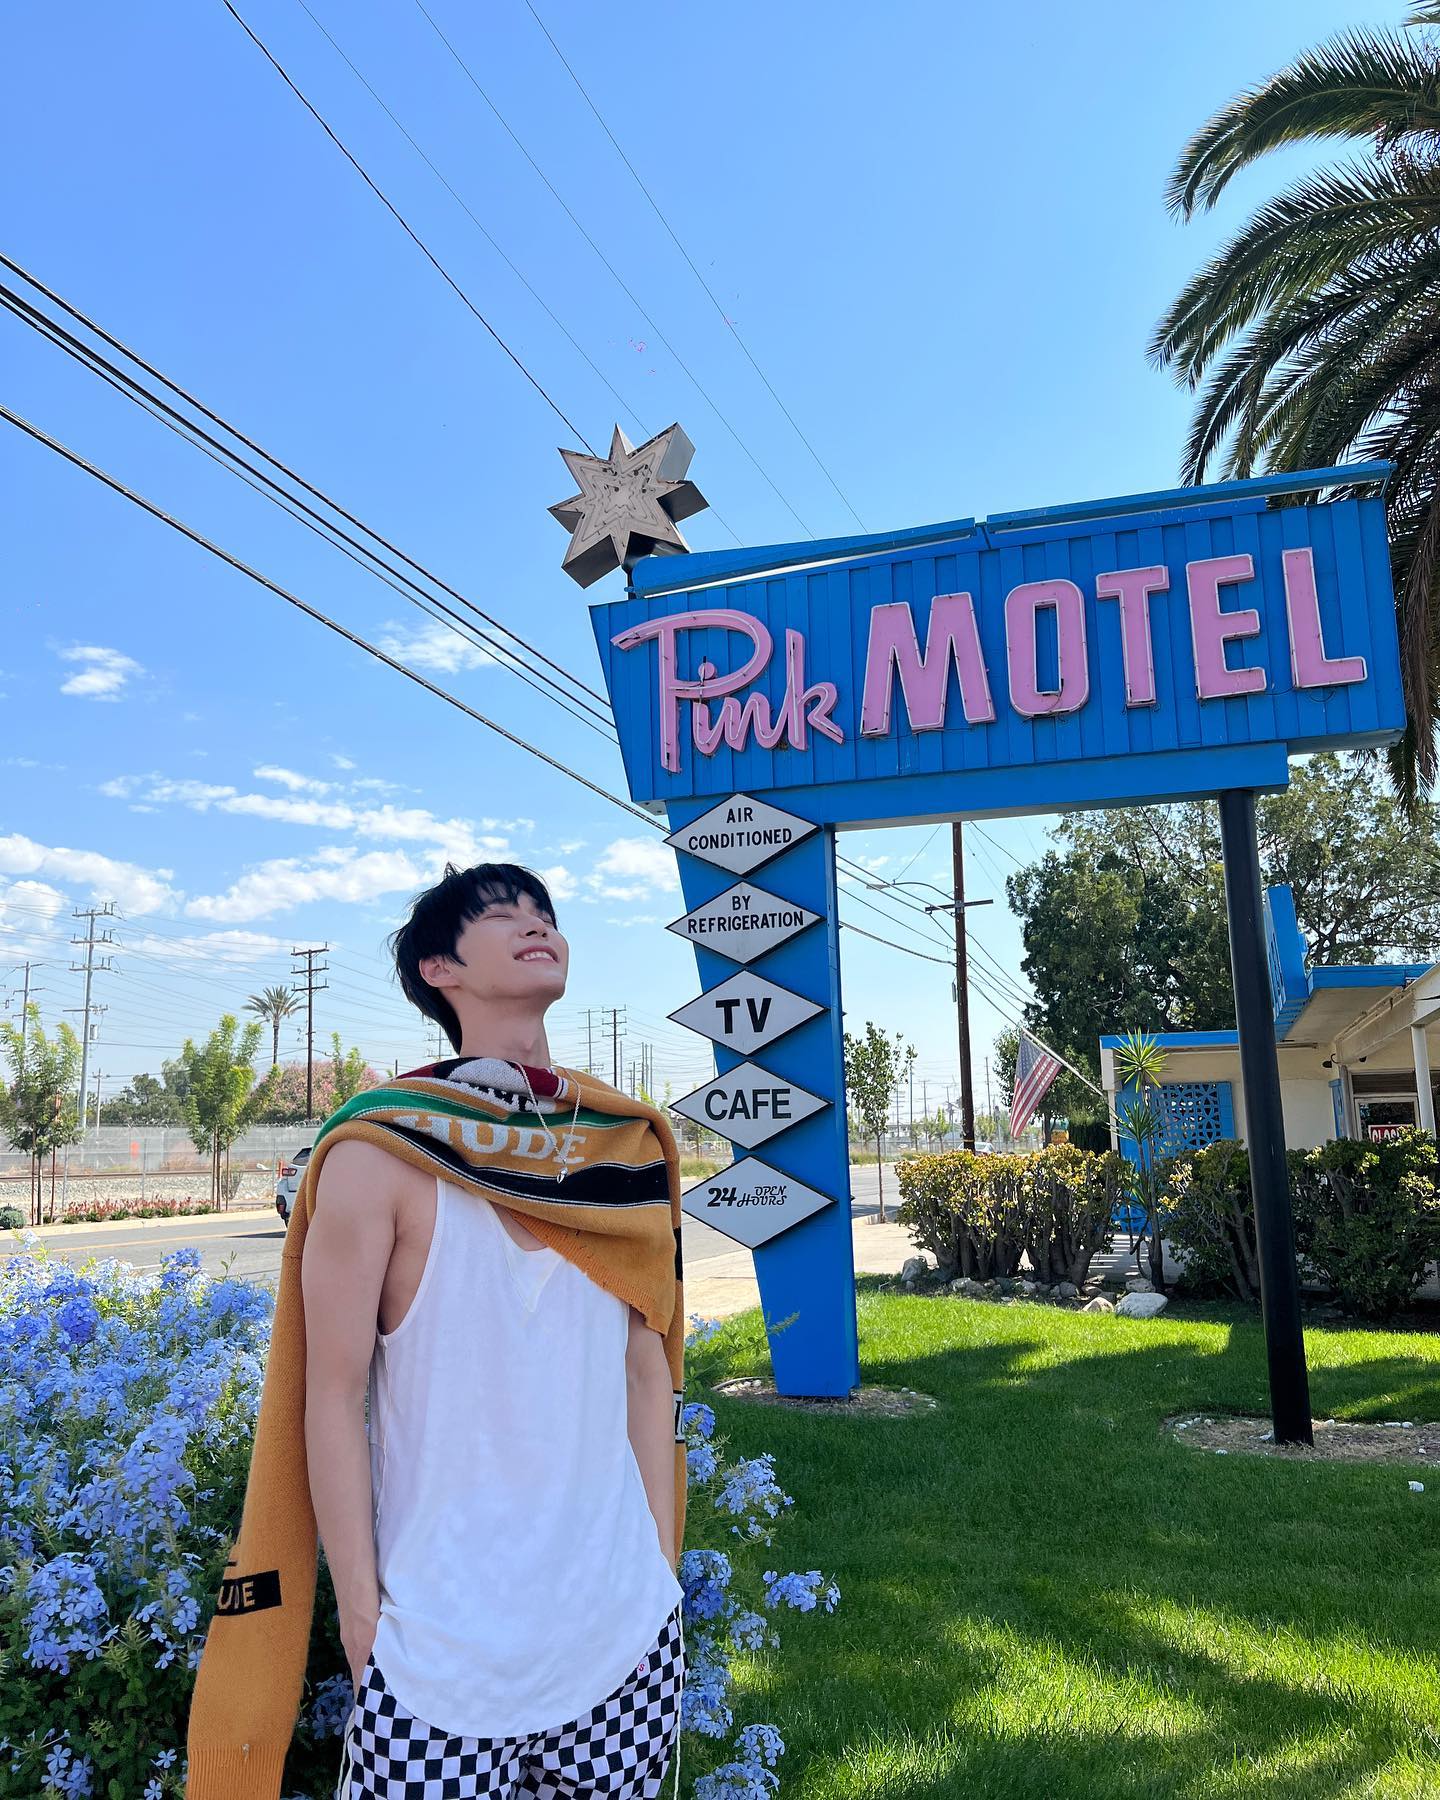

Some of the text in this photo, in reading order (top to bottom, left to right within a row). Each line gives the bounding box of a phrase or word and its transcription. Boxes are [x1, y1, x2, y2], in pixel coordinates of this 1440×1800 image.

[610, 547, 1369, 773] Pink MOTEL
[727, 807, 753, 823] AIR
[688, 828, 792, 850] CONDITIONED
[732, 896, 751, 910] BY
[688, 911, 804, 933] REFRIGERATION
[716, 998, 772, 1034] TV
[705, 1089, 791, 1120] CAFE
[707, 1187, 787, 1207] 24 HOURS
[754, 1185, 787, 1196] OPEN
